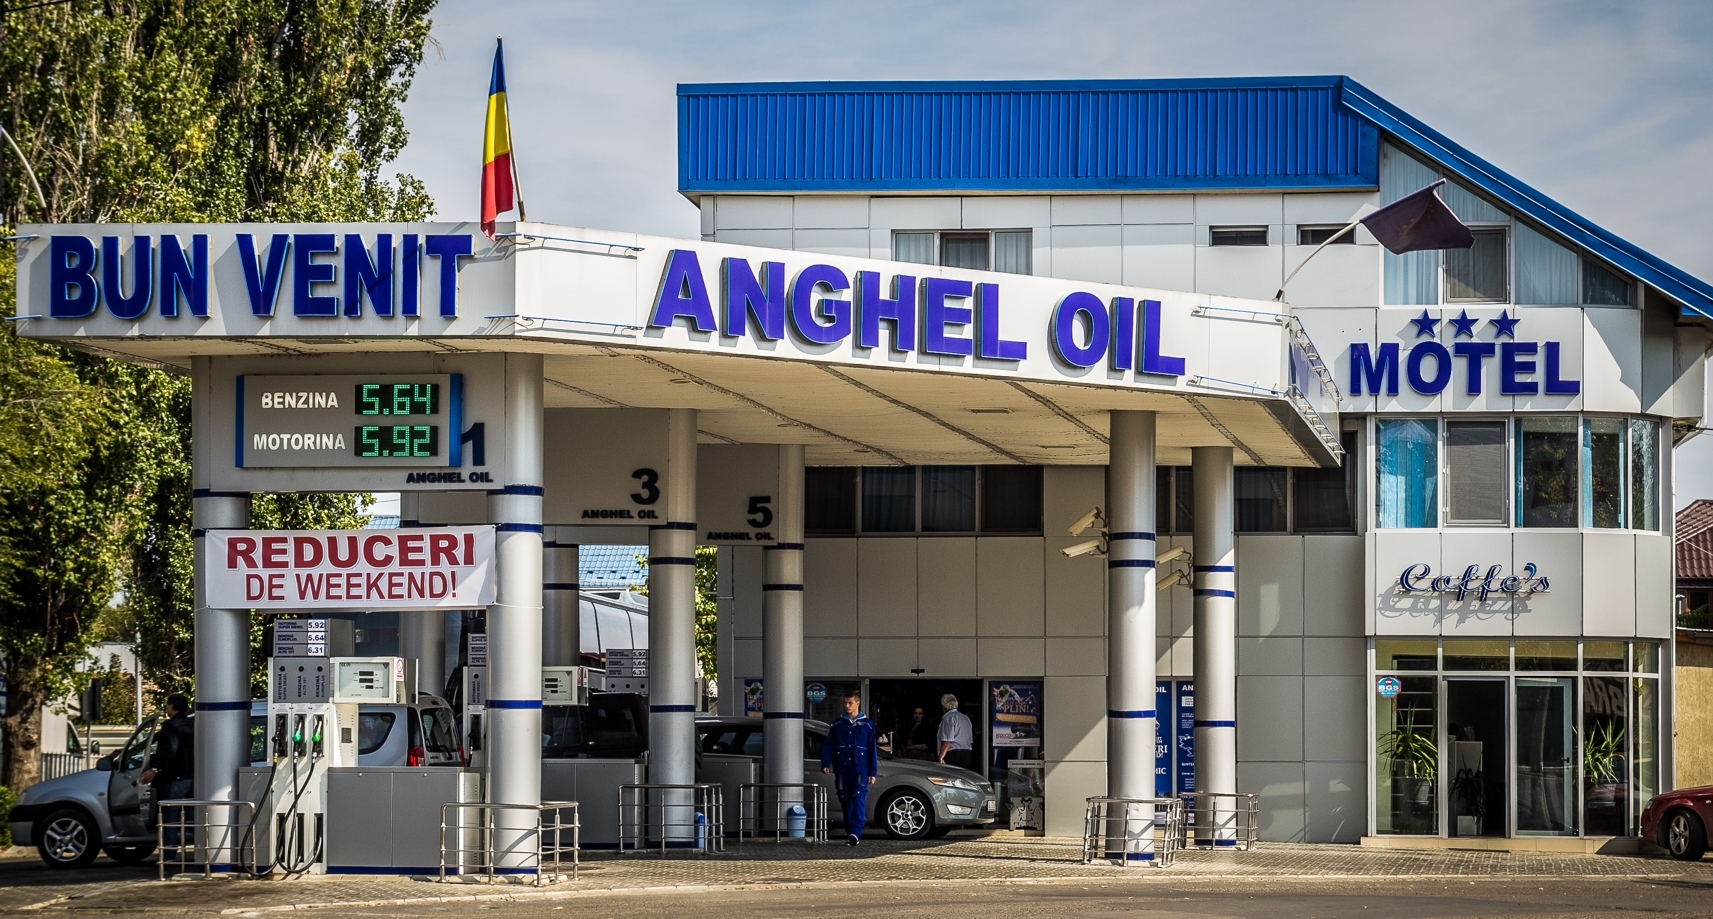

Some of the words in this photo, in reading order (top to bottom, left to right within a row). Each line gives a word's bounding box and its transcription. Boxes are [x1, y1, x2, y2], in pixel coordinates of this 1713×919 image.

[49, 234, 211, 320] BUN
[235, 233, 475, 318] VENIT
[647, 249, 1028, 361] ANGHEL
[1052, 291, 1186, 377] OIL
[1350, 341, 1581, 396] MOTEL
[261, 392, 339, 409] BENZINA
[362, 384, 431, 415] 5.64
[253, 433, 346, 450] MOTORINA
[362, 426, 430, 456] 5.92
[460, 422, 485, 467] 1
[406, 472, 466, 483] ANGHEL
[468, 471, 494, 483] OIL
[630, 468, 660, 505] 3
[581, 509, 634, 519] ANGHEL
[637, 509, 659, 519] OIL
[747, 496, 773, 528] 5
[226, 532, 476, 571] REDUCERI
[706, 532, 752, 541] ANGHEL
[755, 532, 775, 541] OIL
[245, 572, 286, 602] DE
[294, 569, 459, 602] WEEKEND!
[308, 621, 325, 629] 5.92
[308, 634, 325, 642] 5.64
[307, 646, 323, 654] 6.31
